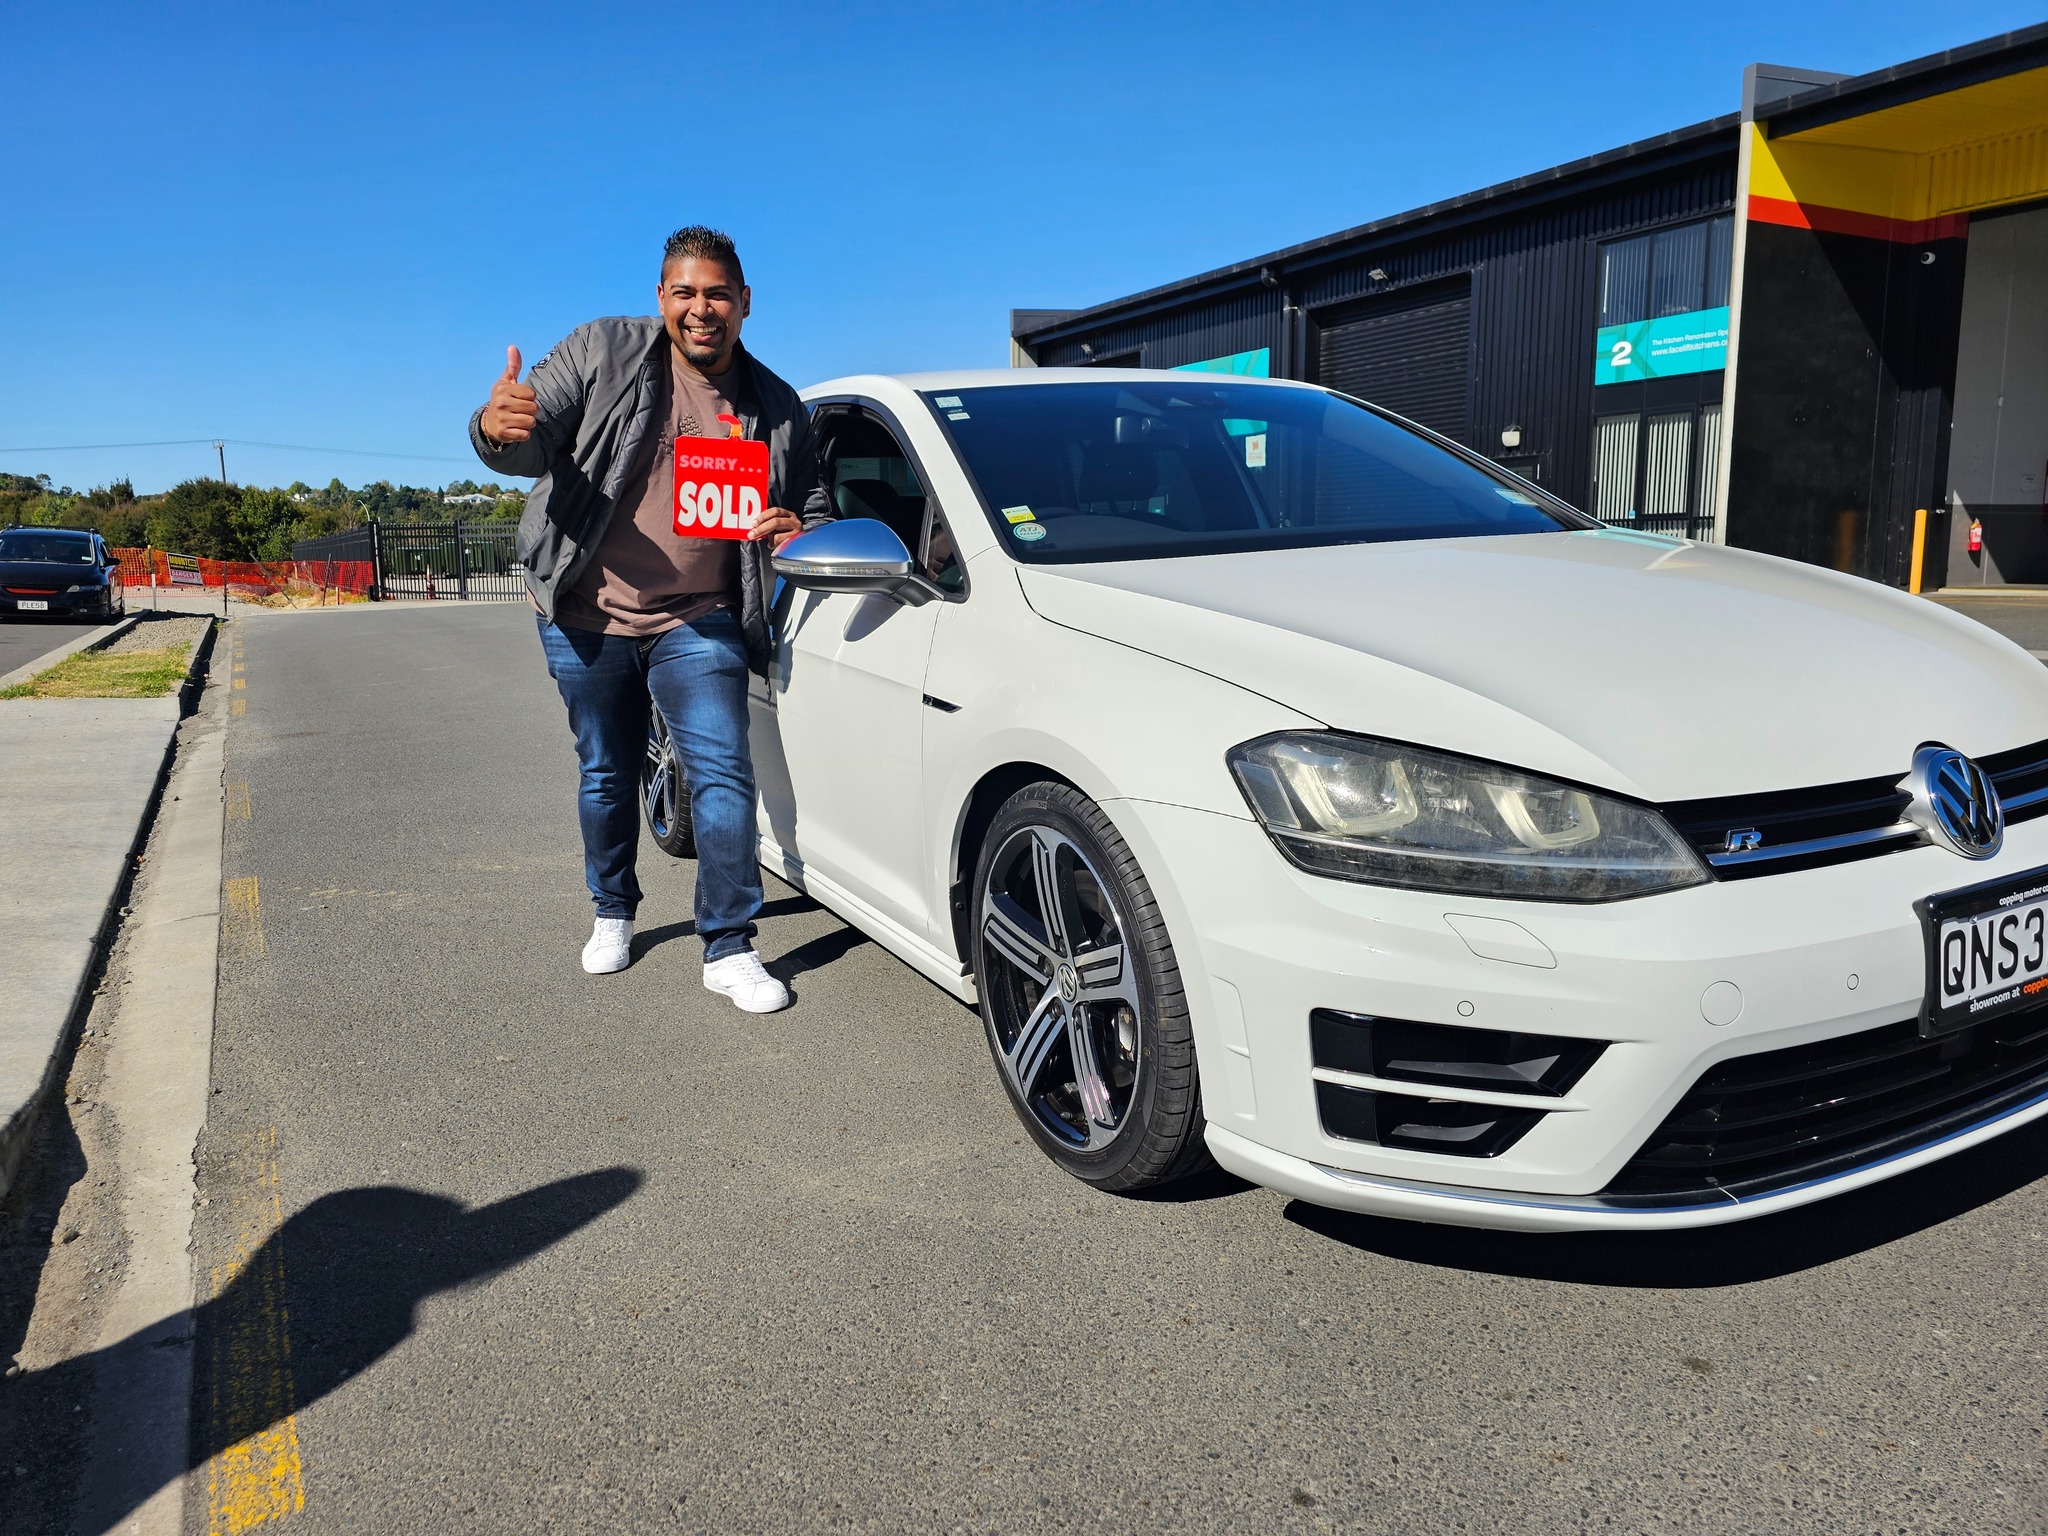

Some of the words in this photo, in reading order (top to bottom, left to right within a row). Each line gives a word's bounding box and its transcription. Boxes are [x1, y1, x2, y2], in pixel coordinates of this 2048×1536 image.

[1652, 338, 1662, 346] The
[1663, 335, 1683, 345] Kitchen
[1685, 330, 1717, 342] Renovation
[1610, 341, 1632, 367] 2
[677, 480, 762, 530] SOLD
[1999, 891, 2024, 907] copping
[2023, 887, 2043, 899] motor
[1943, 907, 2045, 997] QNS3
[1969, 991, 2011, 1013] showroom
[2011, 986, 2021, 998] at
